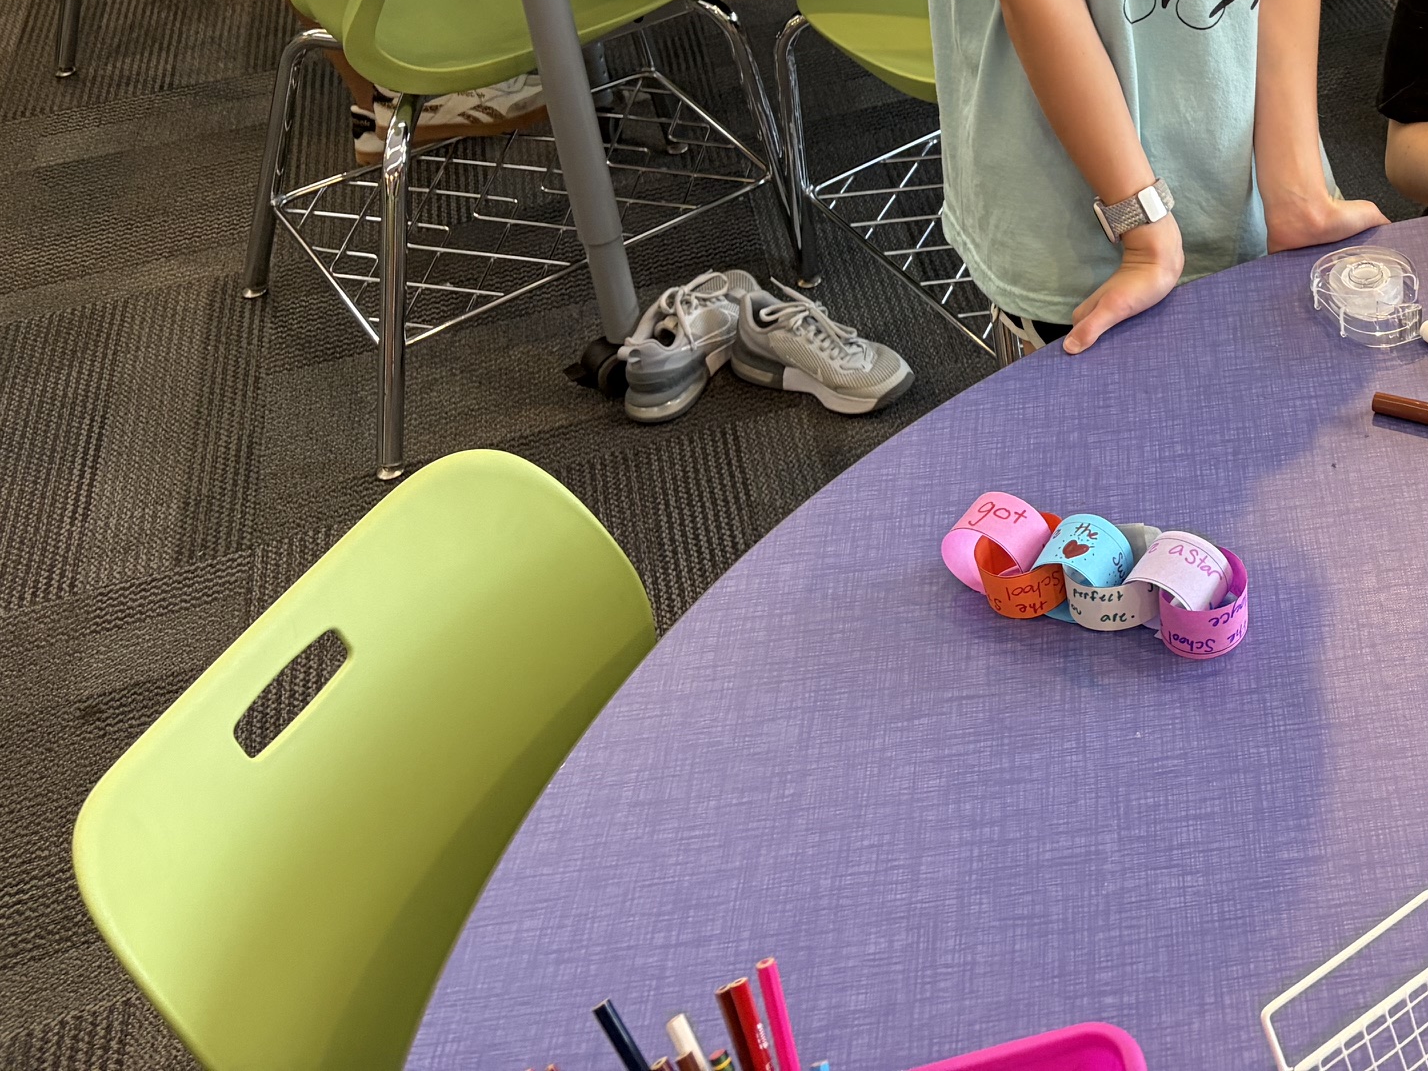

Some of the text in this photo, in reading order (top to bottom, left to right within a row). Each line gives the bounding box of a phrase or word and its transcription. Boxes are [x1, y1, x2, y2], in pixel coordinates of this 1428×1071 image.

[968, 501, 1028, 527] got
[1075, 523, 1099, 541] the
[1005, 570, 1061, 601] School
[1016, 601, 1048, 614] the
[1168, 630, 1216, 653] School
